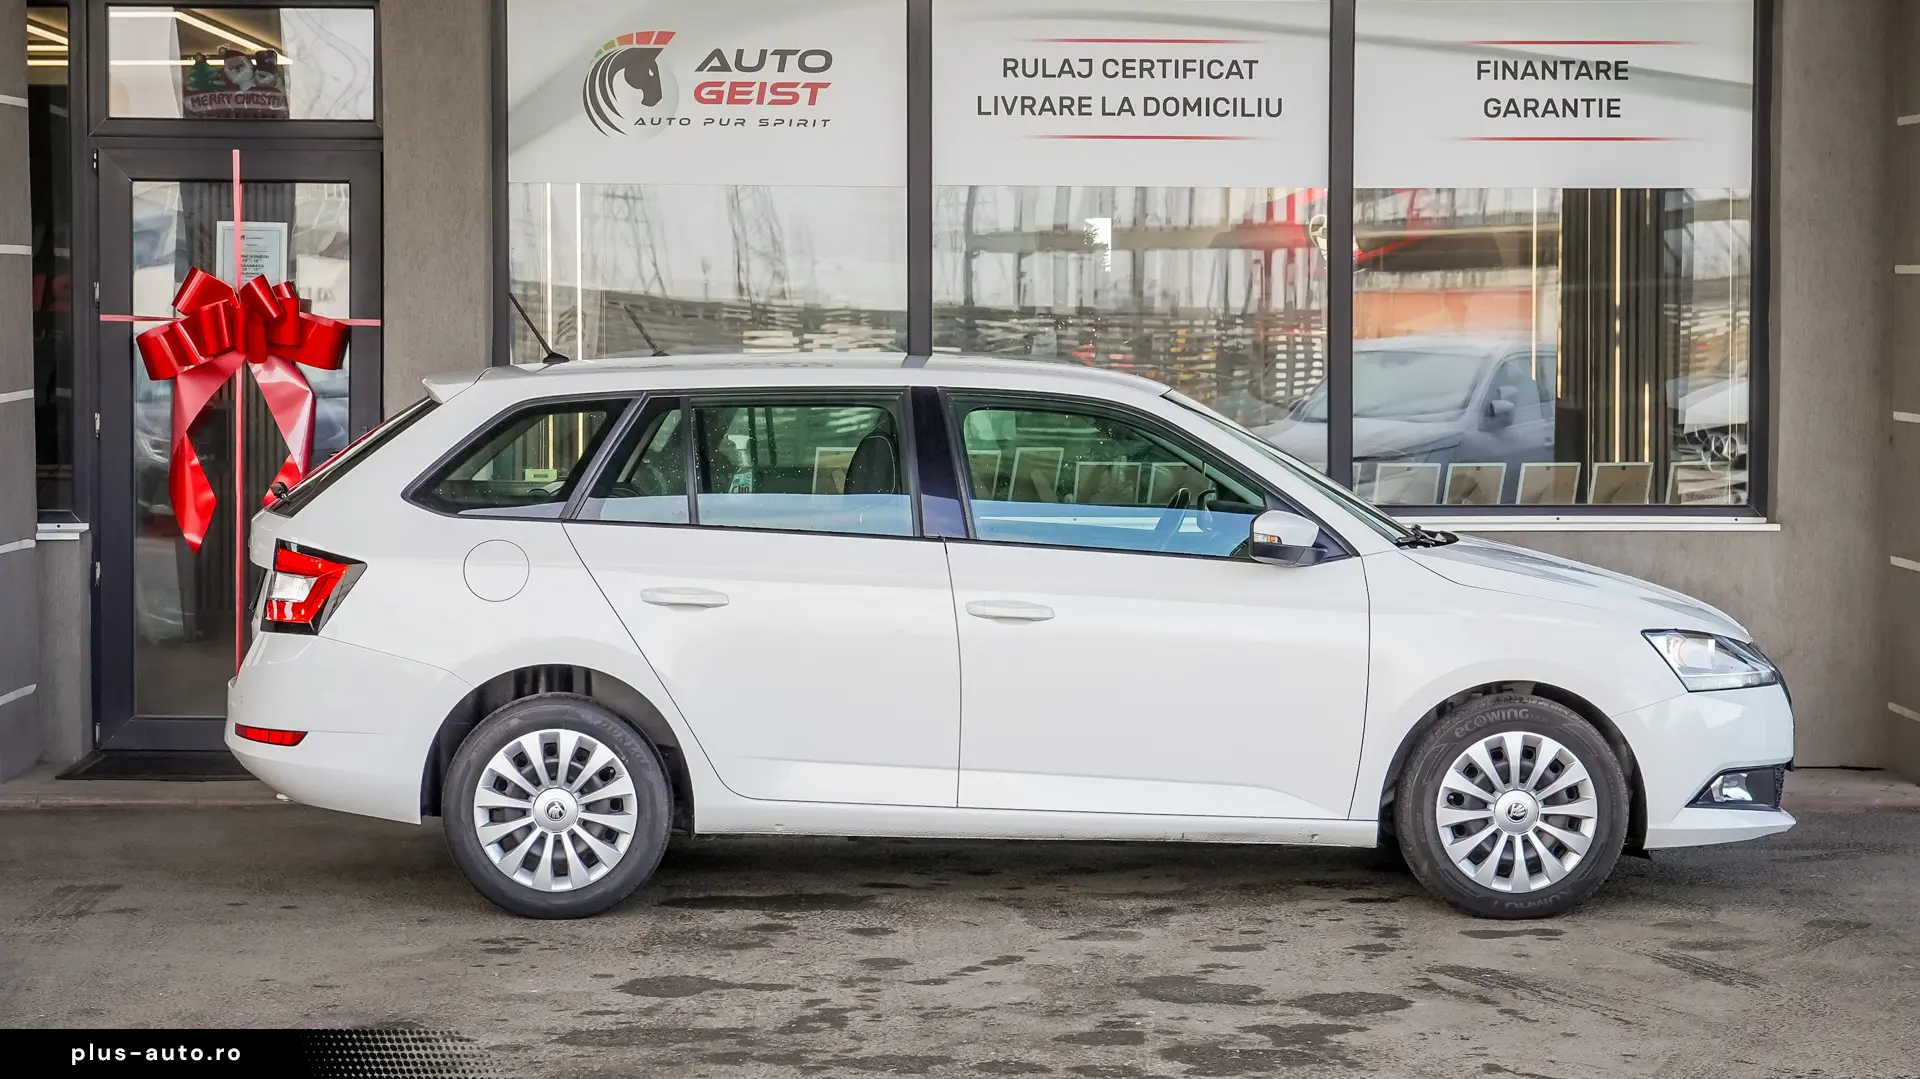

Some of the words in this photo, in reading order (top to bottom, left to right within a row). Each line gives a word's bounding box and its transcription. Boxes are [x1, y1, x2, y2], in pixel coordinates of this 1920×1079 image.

[694, 48, 833, 74] AUTO
[1003, 57, 1093, 79] RULAJ
[1102, 58, 1259, 80] CERTIFICAT
[1476, 60, 1629, 81] FINANTARE
[191, 93, 232, 107] MERRY
[235, 92, 288, 107] CHRISTMA
[693, 81, 832, 106] GEIST
[977, 95, 1092, 116] LIVRARE
[1101, 96, 1136, 117] LA
[1143, 97, 1283, 118] DOMICILIU
[1483, 97, 1621, 118] GARANTIE
[633, 117, 691, 126] AUTO
[703, 118, 746, 127] PUR
[758, 118, 831, 128] SPIRIT
